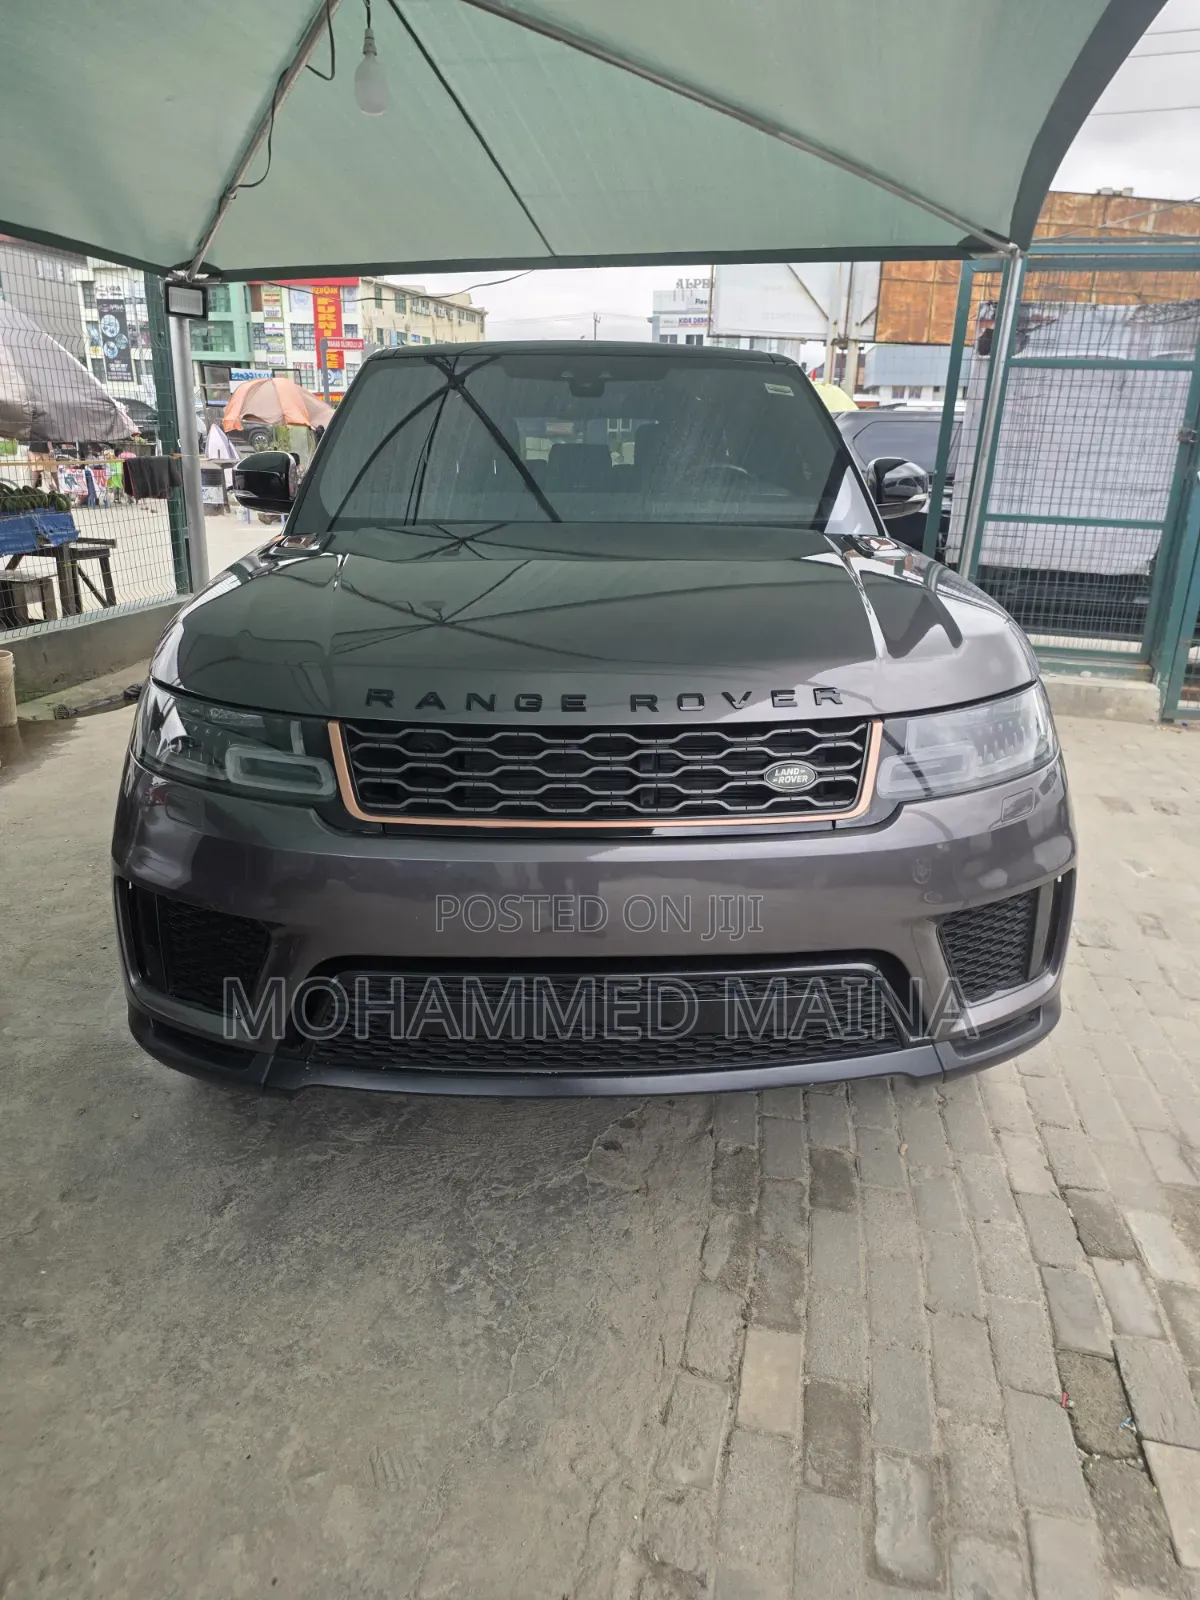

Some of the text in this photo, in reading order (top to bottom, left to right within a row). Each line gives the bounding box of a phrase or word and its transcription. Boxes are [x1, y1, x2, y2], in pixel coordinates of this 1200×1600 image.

[365, 687, 843, 712] RANGE ROVER
[774, 767, 801, 777] LAND
[778, 774, 808, 784] ROVER
